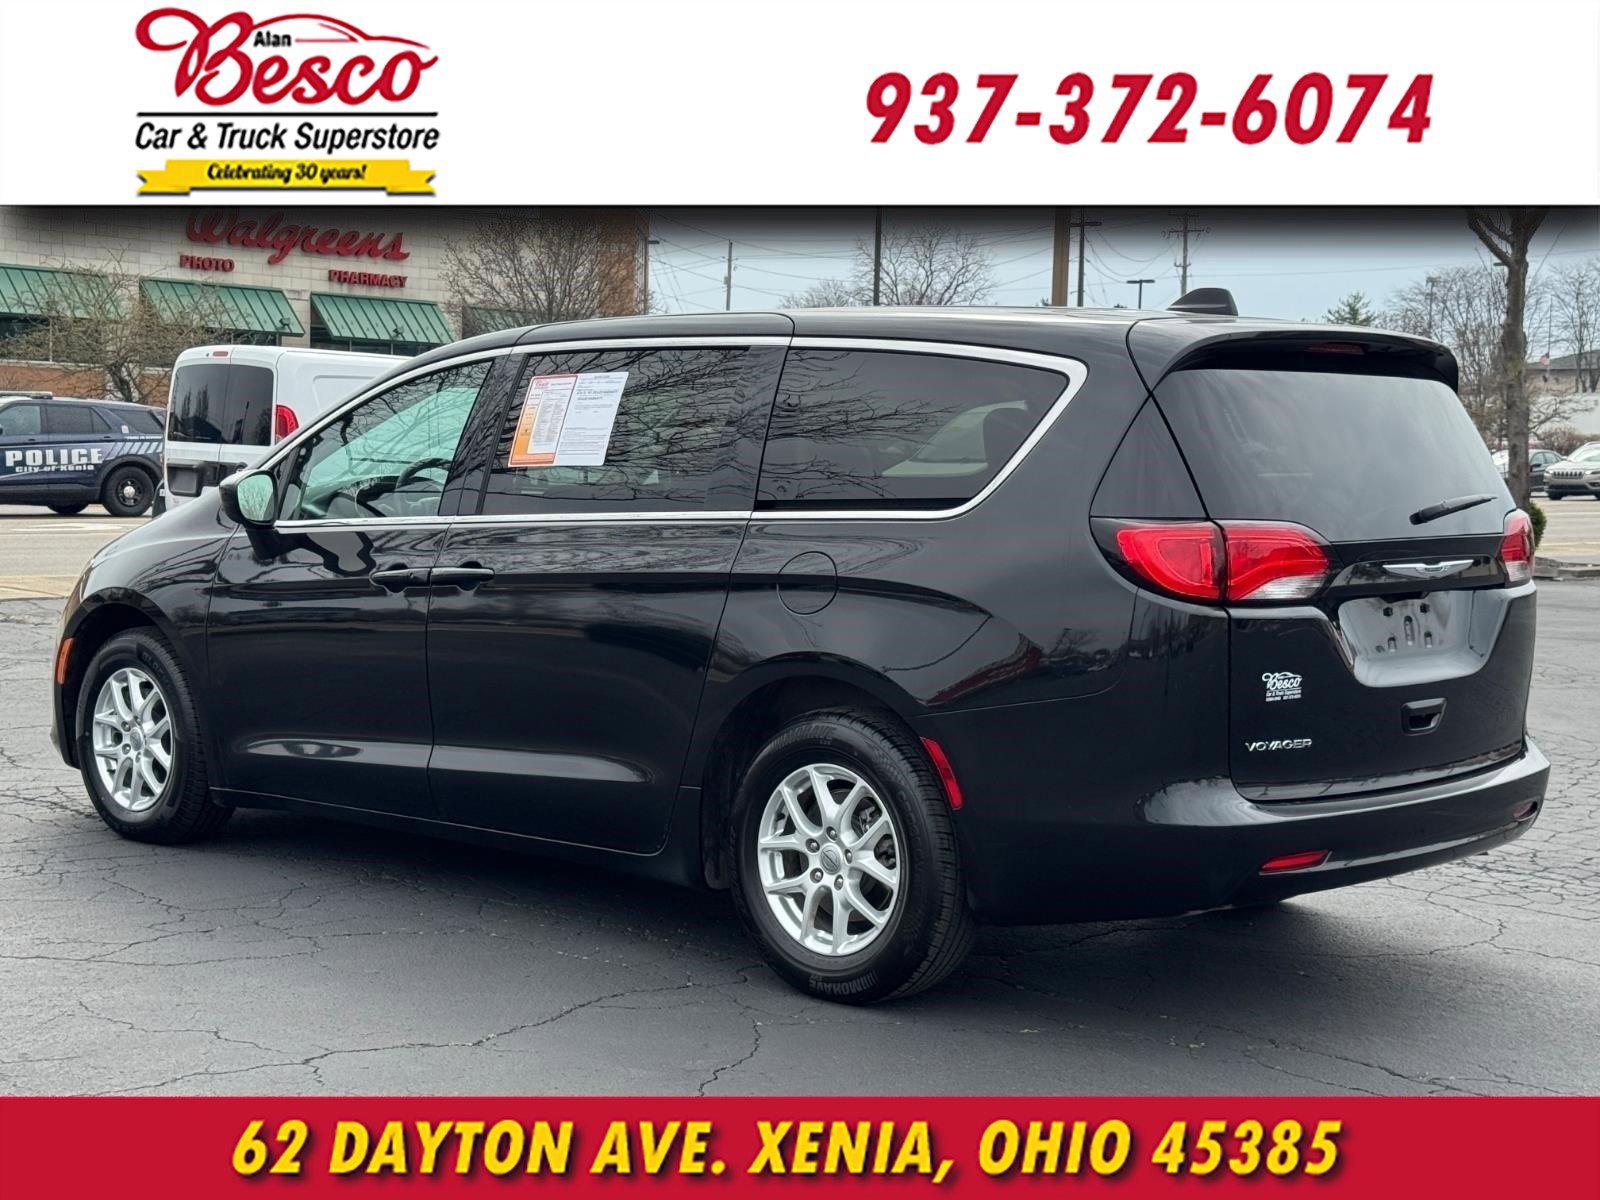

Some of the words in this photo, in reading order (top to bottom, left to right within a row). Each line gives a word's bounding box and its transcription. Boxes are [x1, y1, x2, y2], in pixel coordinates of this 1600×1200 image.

[185, 206, 410, 265] Walgreens
[179, 254, 235, 273] PHOTO
[328, 269, 408, 288] PHARMACY
[5, 448, 104, 467] POLICE
[1244, 738, 1313, 752] VOYAGER
